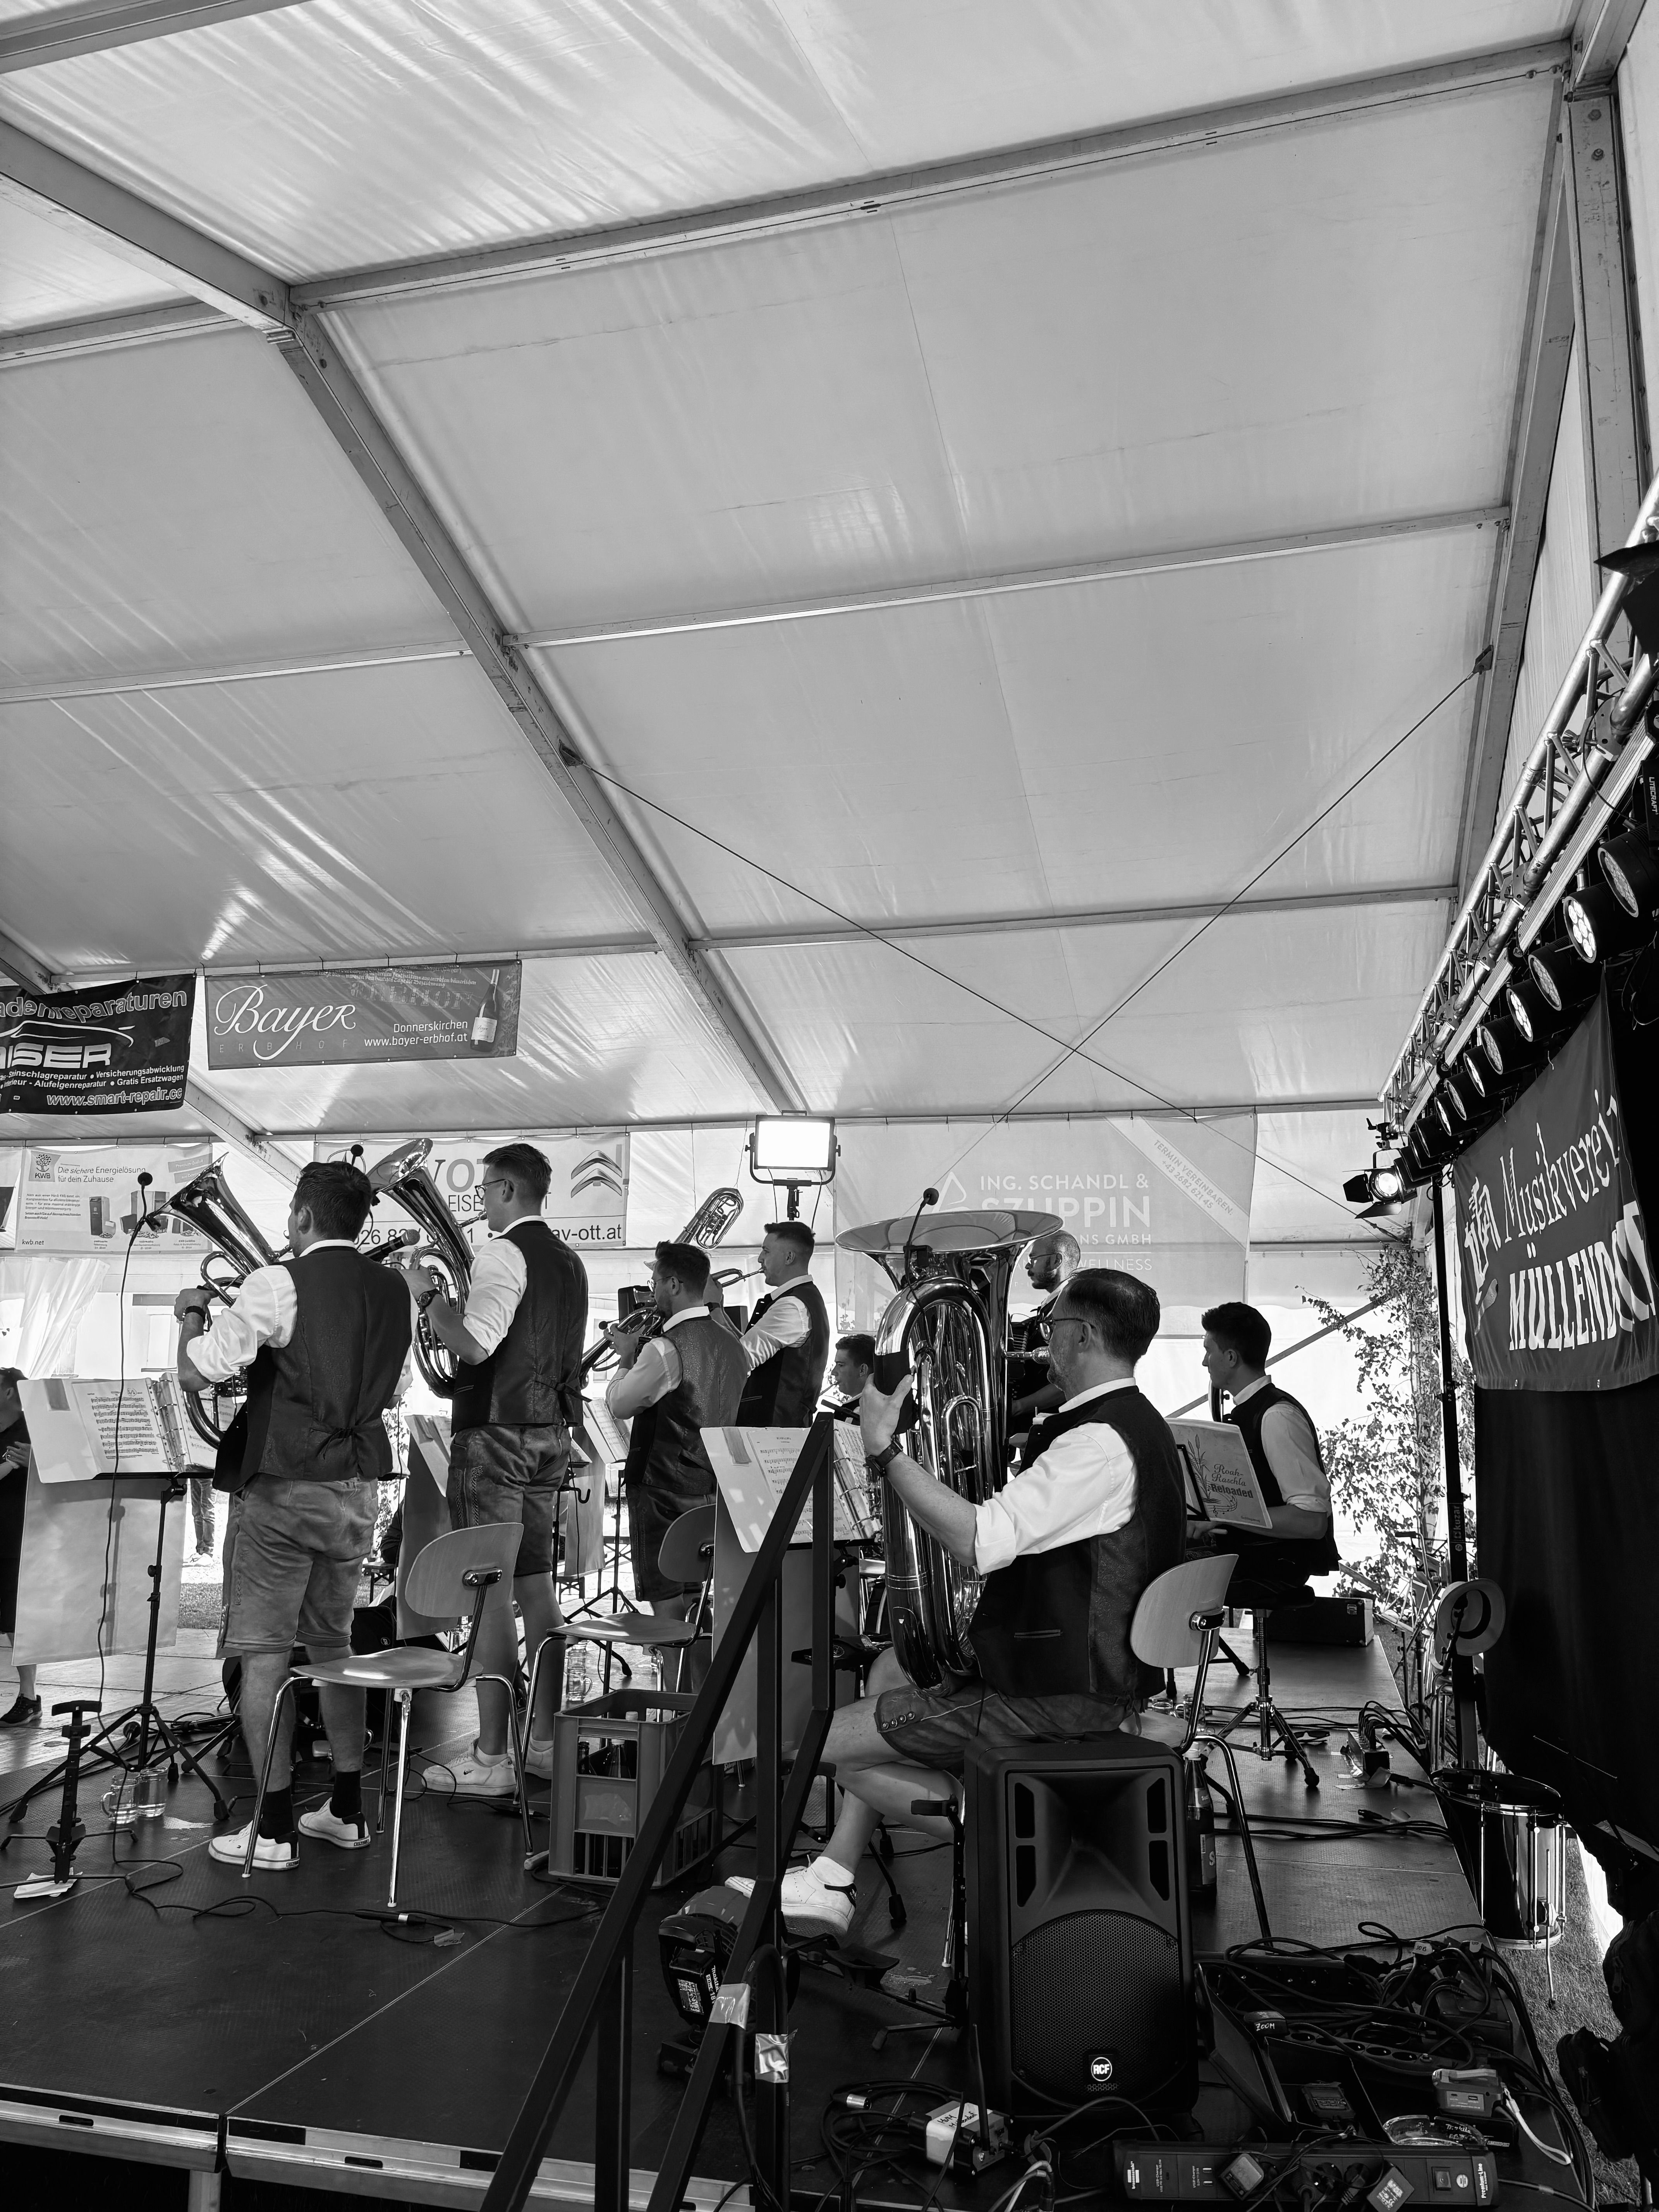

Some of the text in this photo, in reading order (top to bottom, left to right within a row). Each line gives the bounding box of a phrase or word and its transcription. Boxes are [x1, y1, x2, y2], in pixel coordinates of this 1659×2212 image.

[1649, 776, 1658, 813] LITECRAFT
[394, 1020, 468, 1033] Donnerskirchen
[220, 1039, 347, 1053] ERBHOF
[364, 1032, 468, 1047] www.bayer-erbhof.at
[96, 1065, 185, 1078] Versicherungsabwicklung
[34, 1080, 106, 1090] Alufelgenreparatur
[117, 1077, 139, 1085] Gratis
[141, 1074, 184, 1084] Ersatzwagen
[47, 1087, 182, 1106] www.smart-repair.cc
[70, 1165, 94, 1174] sichere
[981, 1173, 1149, 1190] ING. SCHANDL &
[1154, 1140, 1233, 1215] TERMIN VEREINBAREN:
[1162, 1160, 1213, 1209] +43 2682 621 45
[1106, 1234, 1151, 1245] GMBH
[1509, 1200, 1656, 1352] MÜLLEND
[1214, 1464, 1244, 1476] Roah-
[1212, 1473, 1247, 1486] Raschla
[1211, 1484, 1254, 1499] Reloaded
[1093, 2064, 1110, 2075] RCF
[1478, 2163, 1487, 2199] Premium-Line
